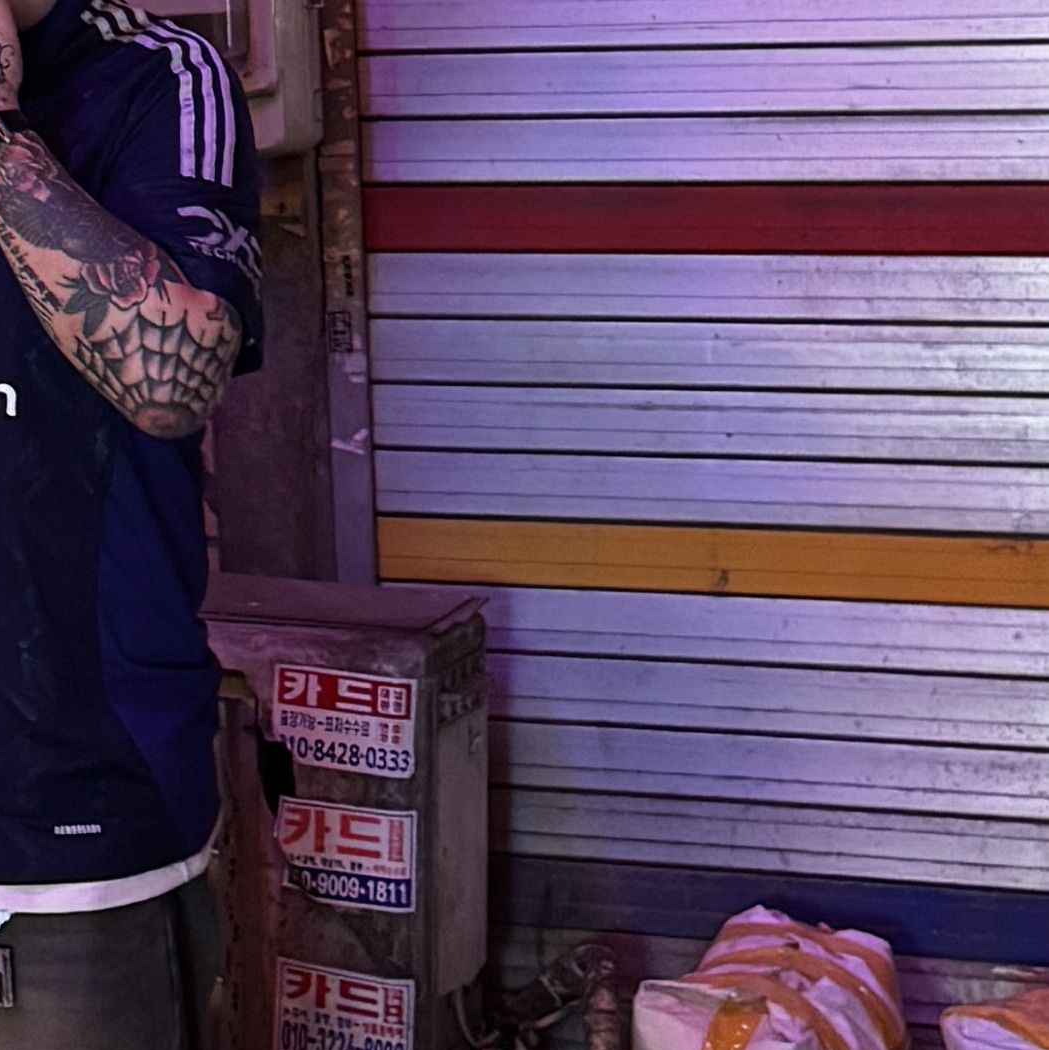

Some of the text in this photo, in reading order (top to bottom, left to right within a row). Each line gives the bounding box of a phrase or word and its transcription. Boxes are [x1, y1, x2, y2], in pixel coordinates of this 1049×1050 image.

[282, 671, 374, 713] 카드
[282, 806, 382, 859] 카드
[285, 967, 379, 1019] 카드
